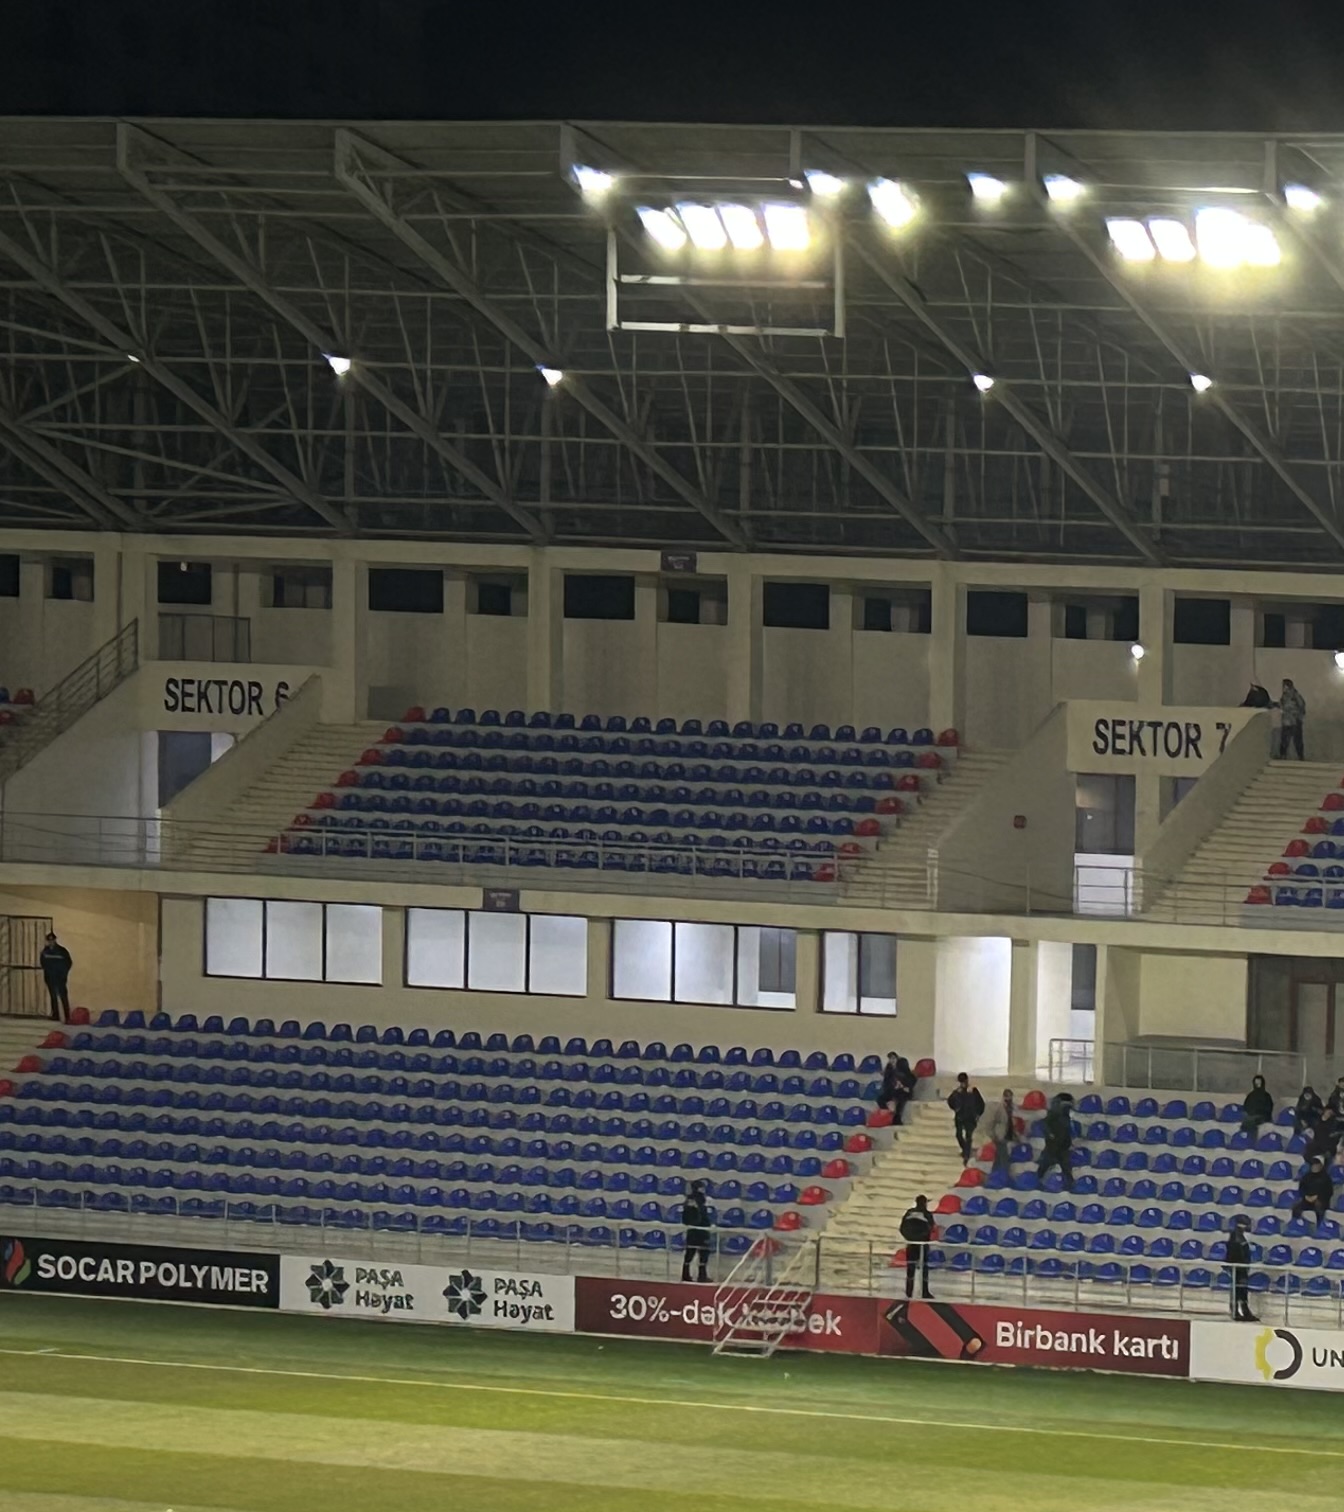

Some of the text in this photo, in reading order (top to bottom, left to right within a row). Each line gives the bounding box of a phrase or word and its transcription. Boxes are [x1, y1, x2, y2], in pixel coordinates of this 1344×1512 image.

[164, 677, 263, 716] SEKTOR
[1093, 718, 1232, 759] SEKTOR 7
[37, 1254, 269, 1294] SOCAR POLYMER
[495, 1278, 543, 1300] PAŞA
[996, 1321, 1179, 1360] Birbank kartı
